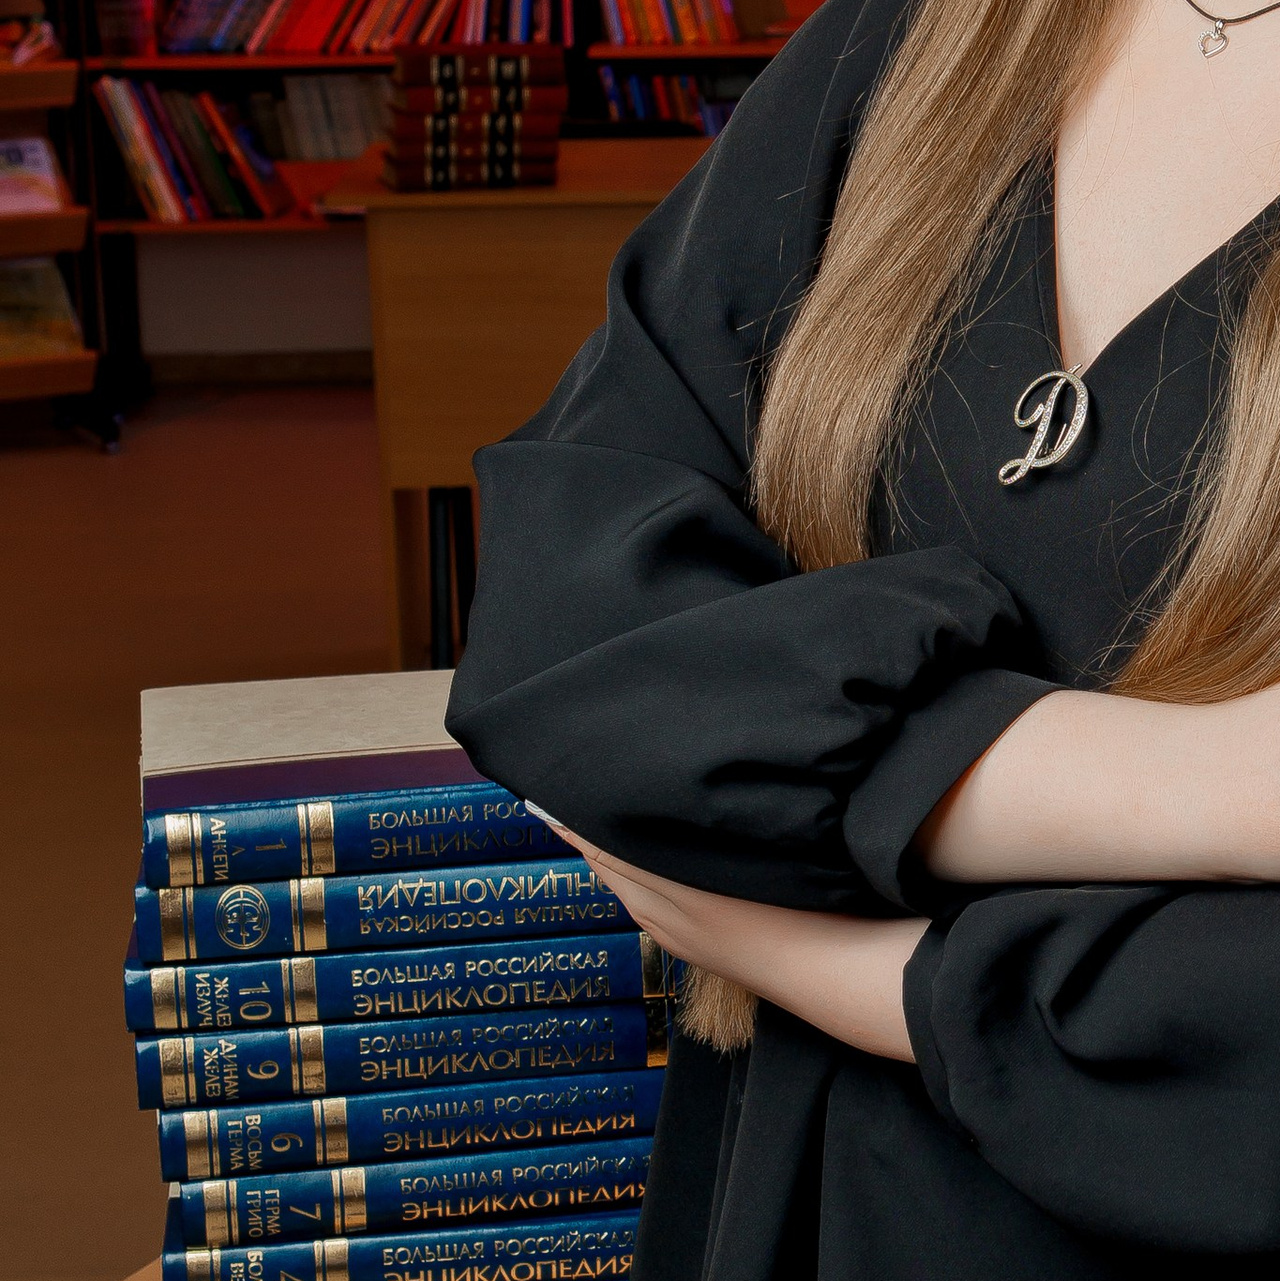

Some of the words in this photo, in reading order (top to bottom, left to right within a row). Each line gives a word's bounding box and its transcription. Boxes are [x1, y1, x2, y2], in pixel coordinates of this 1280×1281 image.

[368, 804, 474, 830] БОЛЬШАЯ
[483, 800, 531, 823] РОС
[209, 817, 230, 881] АНКЕТИ
[255, 838, 288, 852] 1
[359, 909, 504, 935] РОССИЙСКАЯ
[514, 902, 617, 925] БОЛЬШАЯ
[351, 961, 455, 988] БОЛЬШАЯ
[464, 950, 609, 980] РОССИЙСКАЯ
[194, 972, 213, 1028] ИЗЛУЧ
[213, 976, 232, 1028] ЖЕЛЕЗ
[238, 980, 273, 1020] 10
[353, 975, 610, 1017] ЭНЦИКЛОПЕДИЯ
[359, 1029, 463, 1056] БОЛЬШАЯ
[471, 1015, 614, 1046] РОССИЙСКАЯ
[203, 1048, 222, 1098] ЖЕЛЕЗ
[218, 1038, 240, 1100] ДИНАМ
[246, 1060, 280, 1080] 9
[361, 1041, 615, 1083] ЭНЦИКЛОПЕДИЯ
[382, 1100, 486, 1126] БОЛЬШАЯ
[494, 1084, 635, 1116] РОССИЙСКАЯ
[226, 1120, 245, 1171] ГЕРМА
[244, 1114, 263, 1171] ВОСЬМ
[270, 1132, 303, 1153] 6
[383, 1111, 635, 1153] ЭНЦИКЛОПЕДИЯ
[400, 1168, 503, 1194] БОЛЬШАЯ
[512, 1154, 652, 1185] РОССИЙСКАЯ
[246, 1190, 264, 1238] ГРИГО
[263, 1189, 282, 1237] ГЕРМА
[288, 1203, 322, 1220] 7
[382, 1241, 485, 1266] БОЛЬШАЯ
[494, 1228, 634, 1258] РОССИЙСКАЯ
